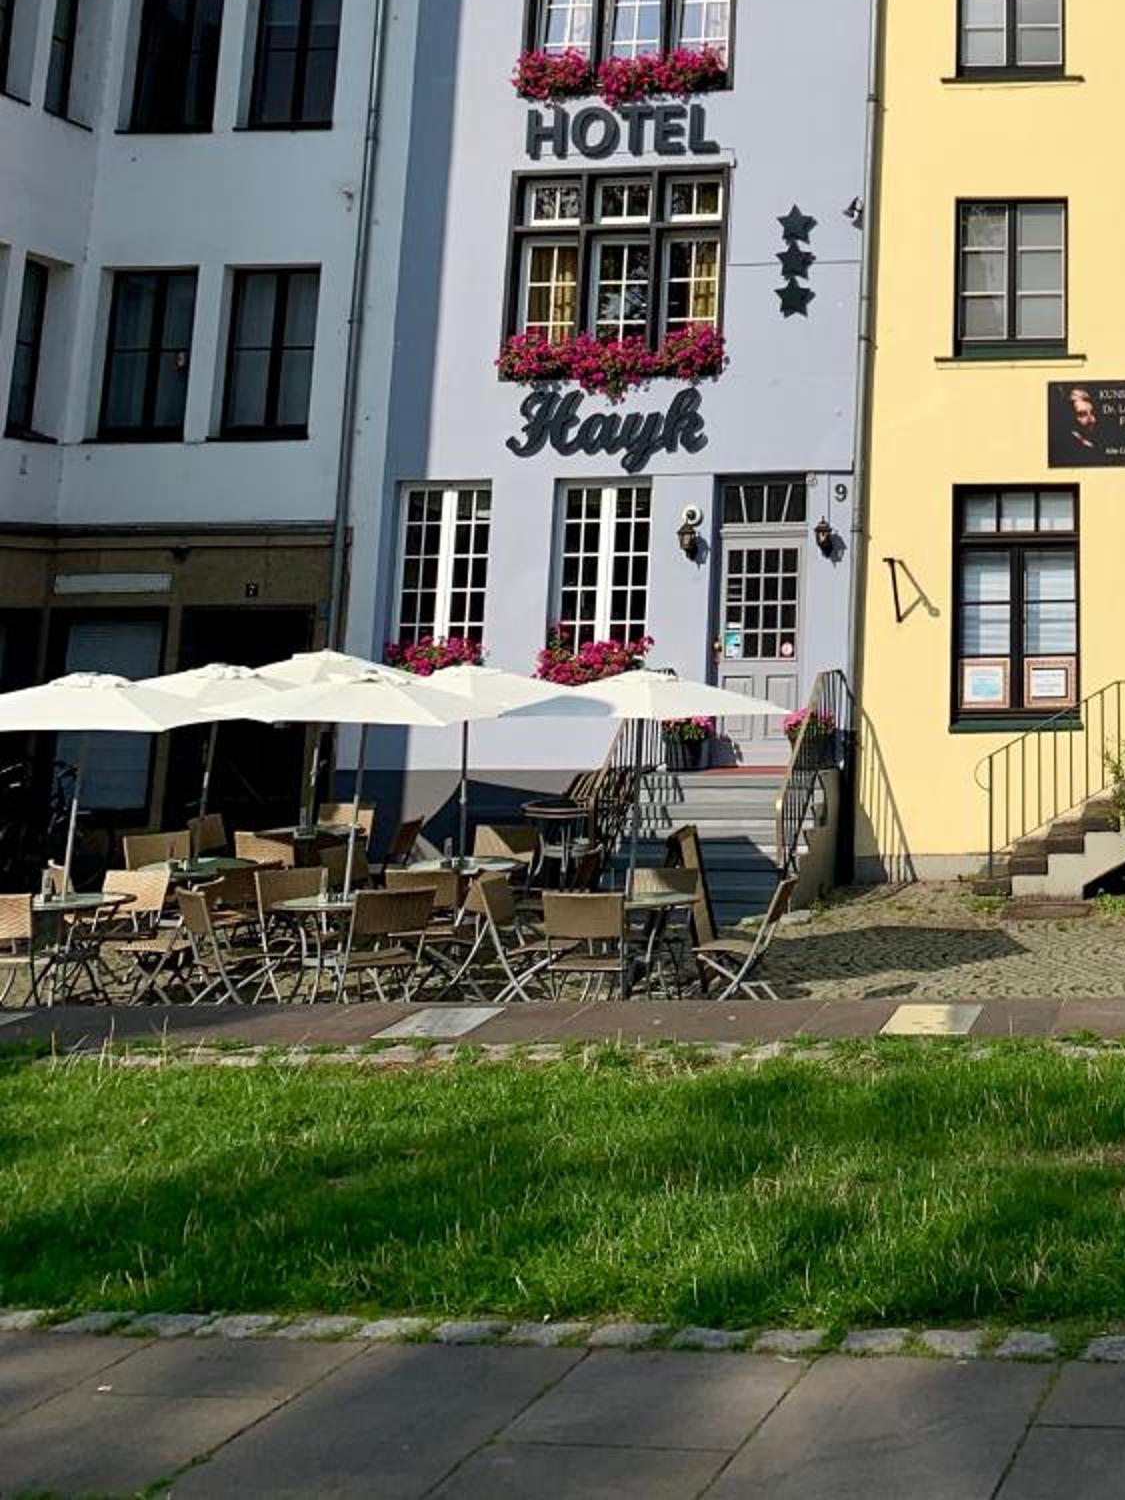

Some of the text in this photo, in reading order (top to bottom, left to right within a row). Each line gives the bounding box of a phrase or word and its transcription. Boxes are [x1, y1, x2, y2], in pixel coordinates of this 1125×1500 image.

[525, 104, 721, 161] HOTEL
[505, 387, 708, 473] Hayk
[834, 483, 848, 503] 9
